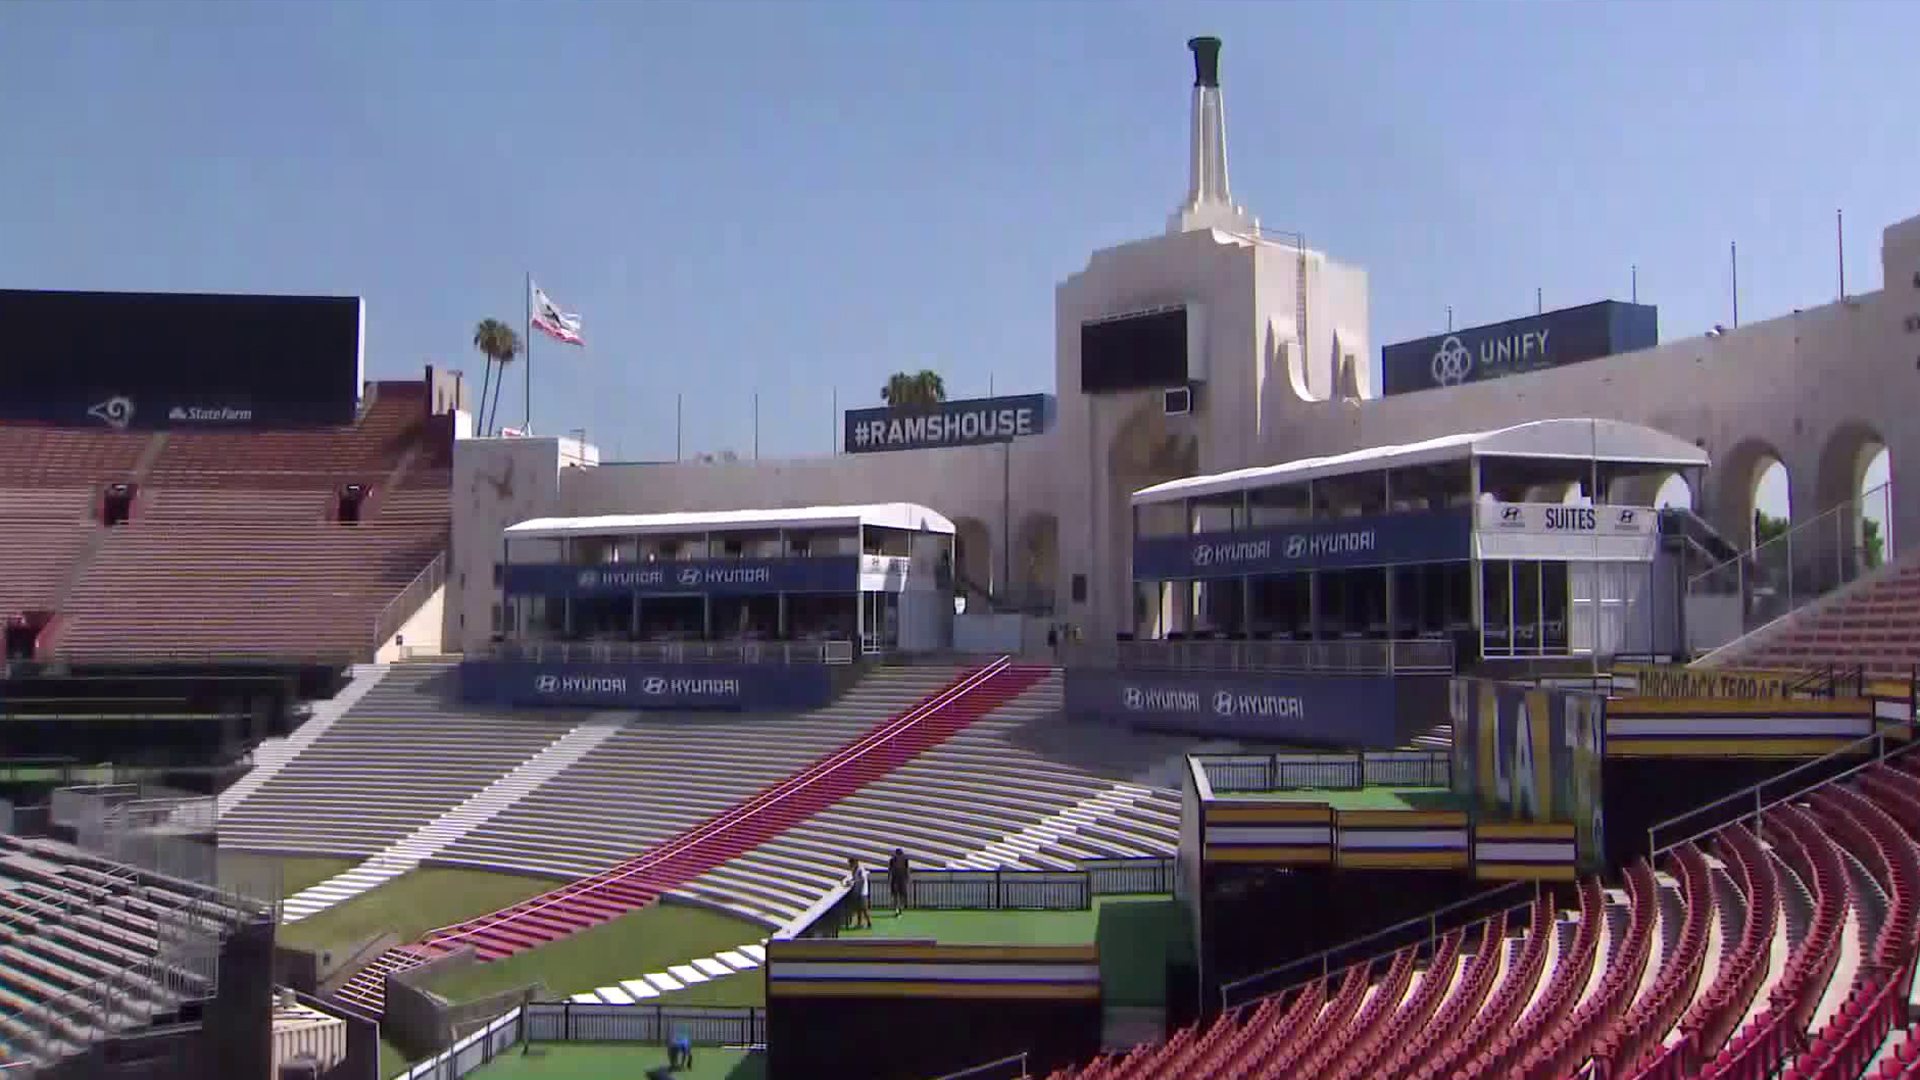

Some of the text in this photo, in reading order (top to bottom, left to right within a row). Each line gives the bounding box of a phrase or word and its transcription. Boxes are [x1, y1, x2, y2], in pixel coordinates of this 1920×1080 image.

[1481, 328, 1549, 363] UNIFY
[855, 407, 1032, 447] #RAMSHOUSE
[1546, 508, 1596, 530] SUITES
[1215, 530, 1375, 563] HYUNDAI HYUNDAI
[603, 566, 770, 584] HYUNDAI HYUNDAI
[563, 677, 739, 695] HYUNDAI HYUNDAI
[1639, 670, 1718, 697] THROWBACK
[1146, 689, 1304, 719] HYUNDAI HYUNDAI
